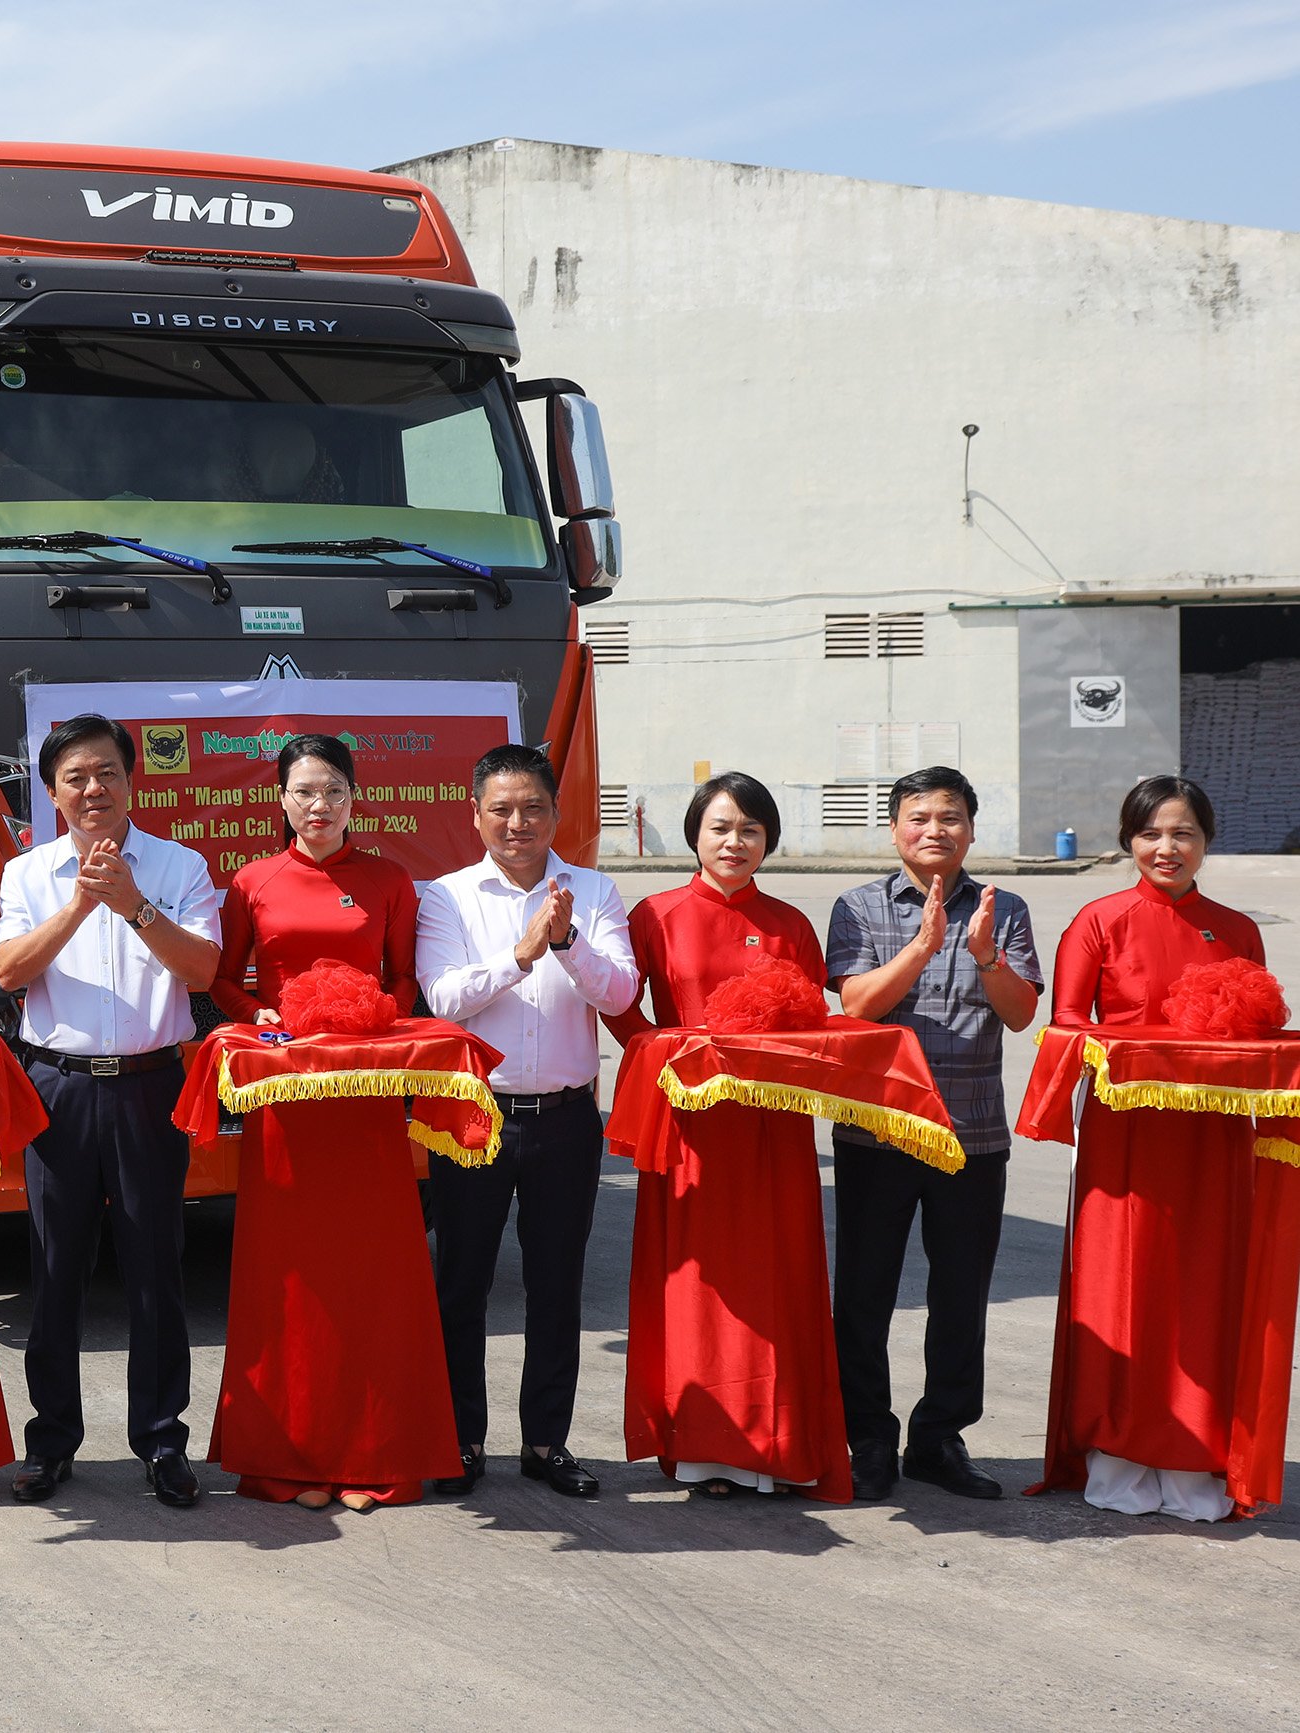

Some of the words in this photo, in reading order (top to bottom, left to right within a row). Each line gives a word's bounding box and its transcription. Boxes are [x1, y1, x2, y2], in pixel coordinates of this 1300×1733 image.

[131, 312, 338, 332] DISCOVERY
[161, 552, 187, 562] HOWO
[451, 558, 475, 568] HOWO
[138, 785, 178, 809] trình
[185, 786, 243, 806] "Mang
[367, 785, 394, 802] con
[399, 783, 435, 803] vùng
[439, 783, 467, 802] bão
[170, 818, 204, 840] tỉnh
[210, 819, 240, 838] Lào
[245, 817, 277, 838] Cai,
[383, 815, 418, 833] 2024
[219, 852, 247, 873] (Xe
